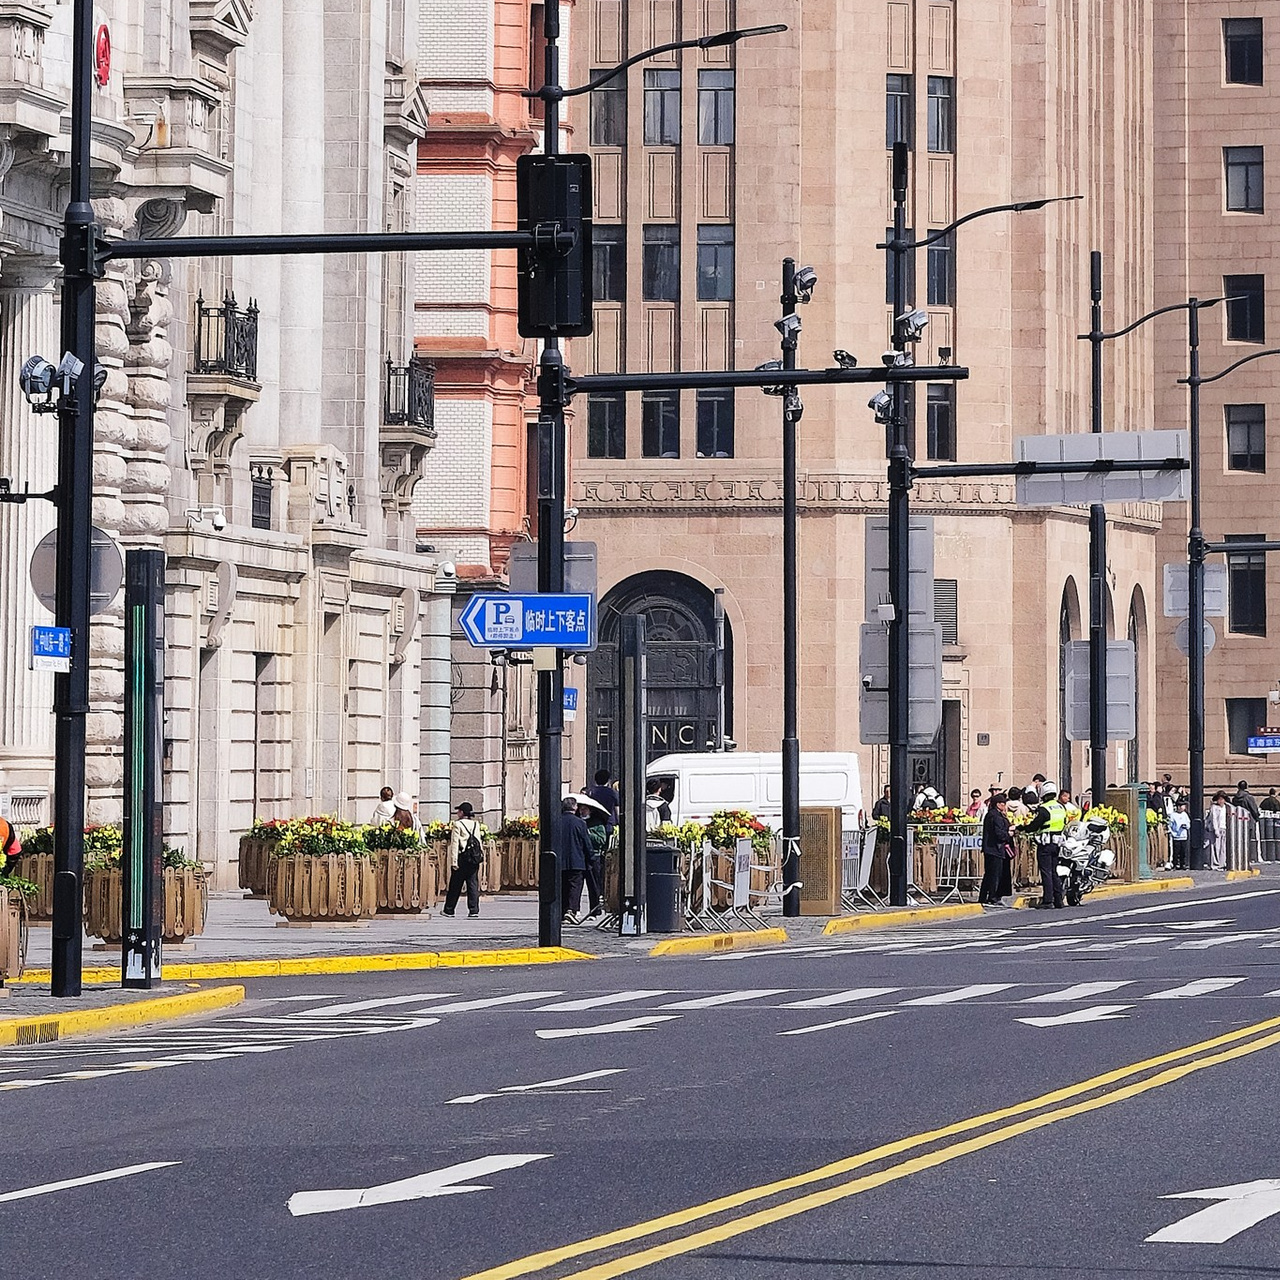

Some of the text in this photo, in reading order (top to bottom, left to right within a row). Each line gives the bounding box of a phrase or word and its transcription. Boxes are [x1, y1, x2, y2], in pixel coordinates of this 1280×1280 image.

[493, 603, 511, 625] P
[525, 609, 586, 632] 临时上下客点
